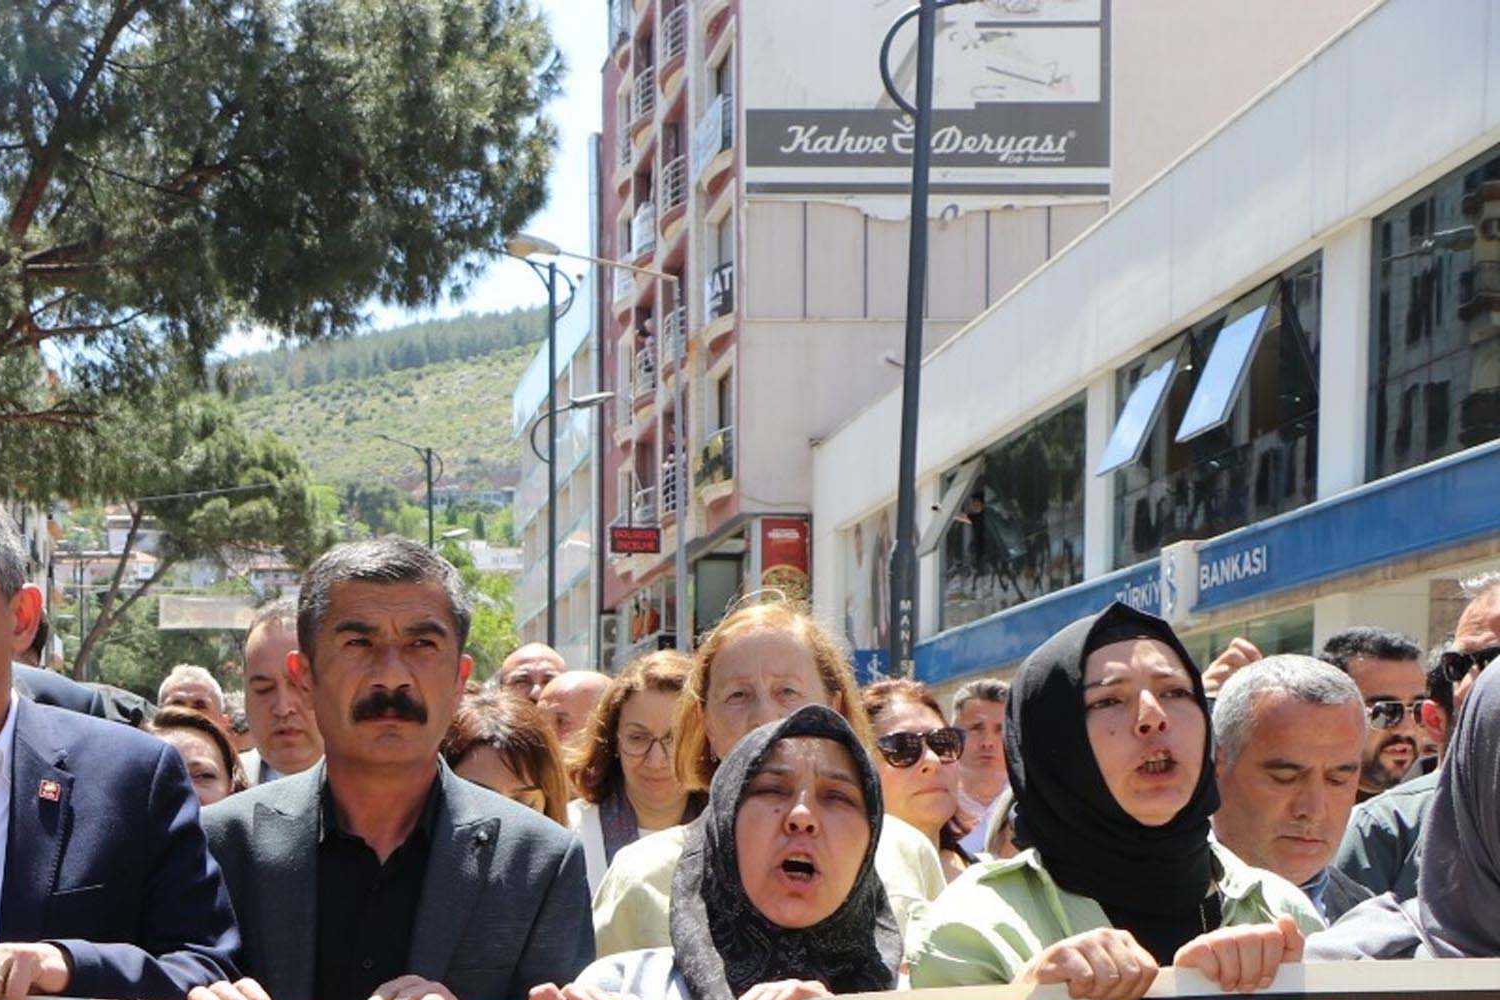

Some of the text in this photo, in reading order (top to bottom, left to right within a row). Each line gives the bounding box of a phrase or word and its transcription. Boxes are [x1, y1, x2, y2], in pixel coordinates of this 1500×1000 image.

[780, 125, 1067, 162] Kahve Deryası
[1115, 576, 1164, 608] TÜRKİY
[1200, 545, 1267, 591] BANKASI
